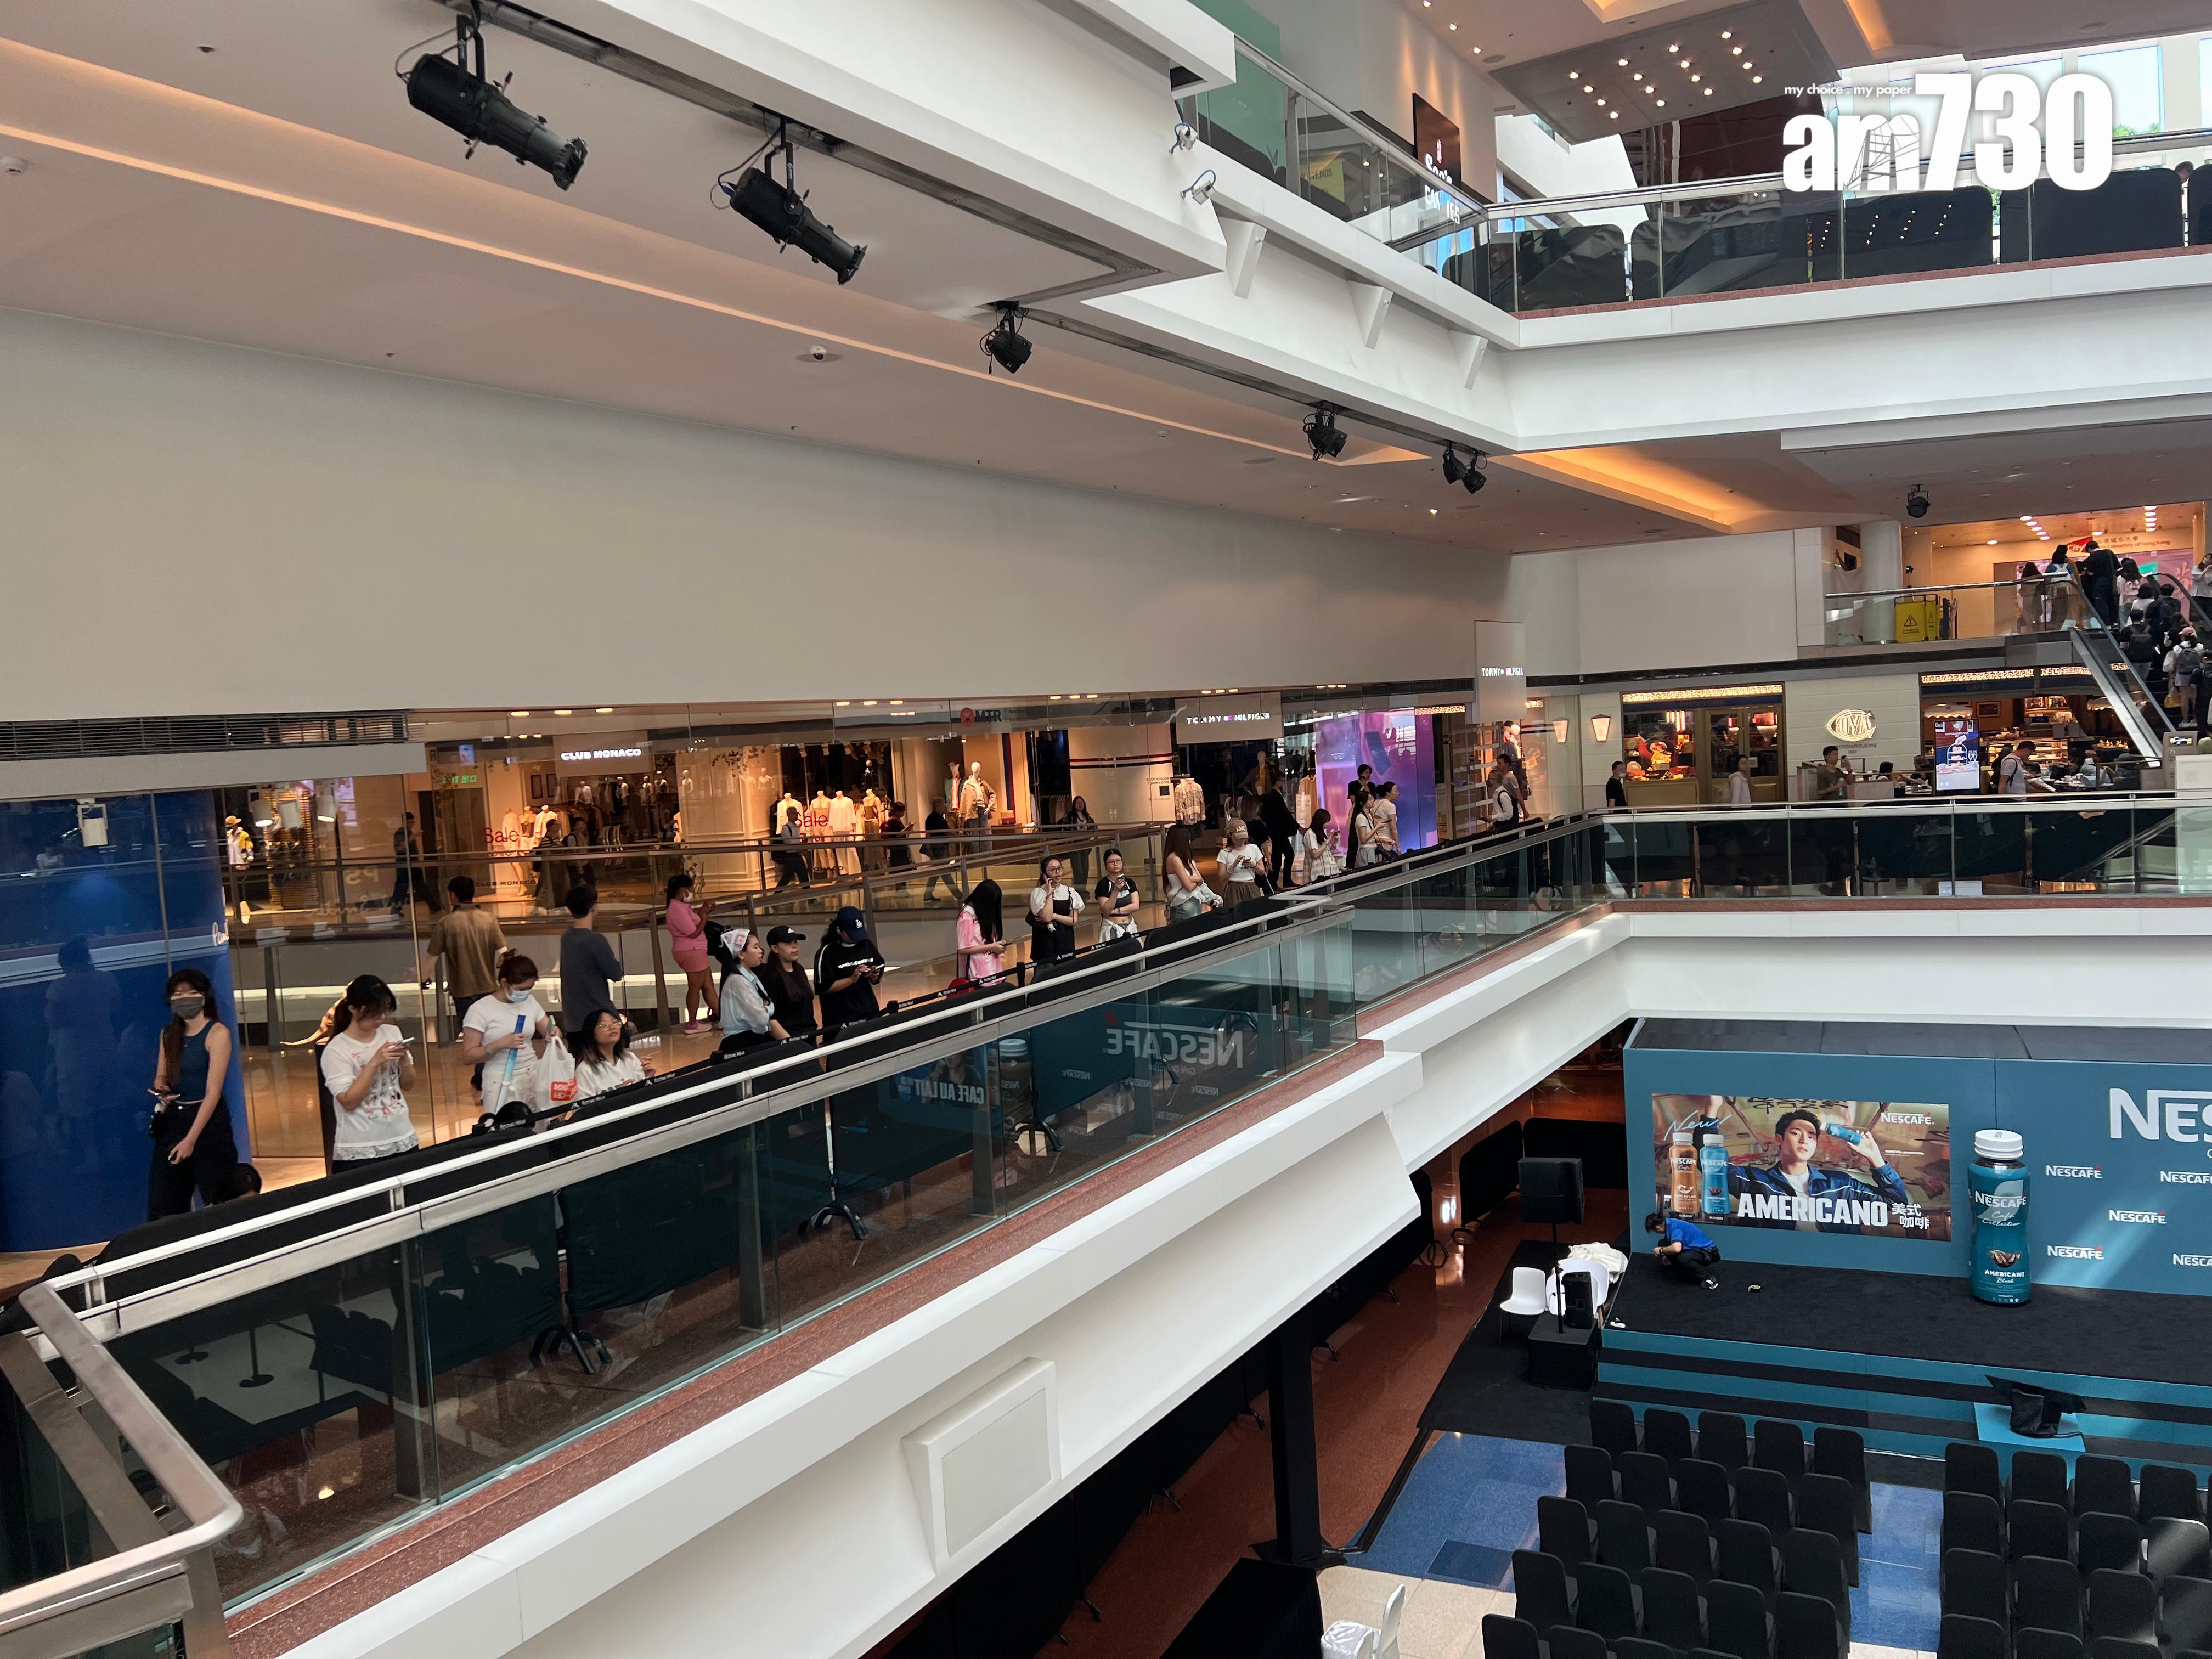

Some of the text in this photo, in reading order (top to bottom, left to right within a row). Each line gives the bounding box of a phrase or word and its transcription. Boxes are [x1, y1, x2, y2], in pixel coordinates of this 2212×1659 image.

[1425, 184, 1460, 225] CANIES
[1481, 667, 1523, 676] TOMMY HILFIGER
[975, 709, 1002, 723] MTR
[561, 748, 642, 761] CLUB MONACO
[483, 827, 520, 843] Sale
[2160, 1171, 2212, 1184] NESCAF
[1737, 1193, 1888, 1227] AMERICANO
[1892, 1202, 1922, 1217] 美式
[1899, 1215, 1930, 1230] 咖啡
[1984, 1269, 2025, 1277] AMERICANO
